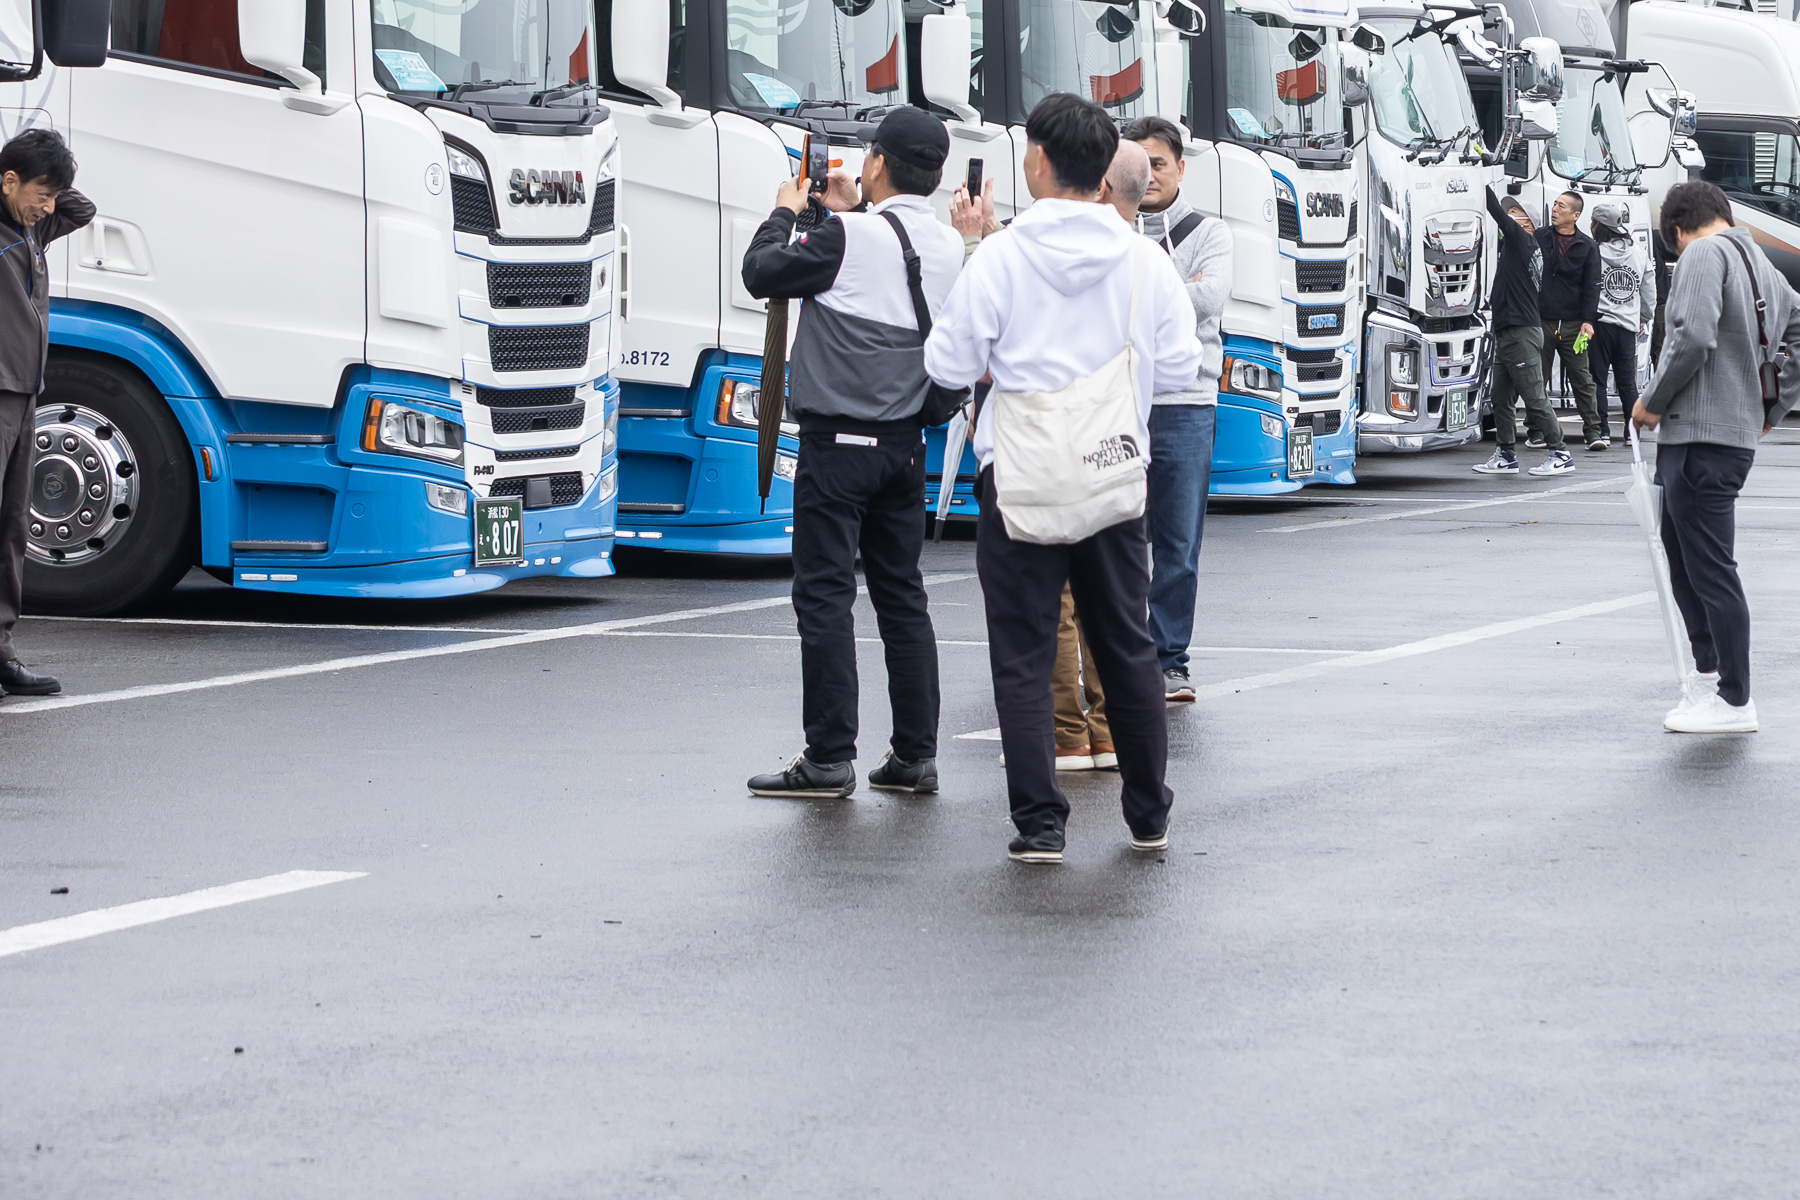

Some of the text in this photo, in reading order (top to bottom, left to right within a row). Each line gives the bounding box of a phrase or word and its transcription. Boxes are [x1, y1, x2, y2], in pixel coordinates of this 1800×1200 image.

[507, 168, 587, 206] SCANIA
[1415, 181, 1433, 190] GIGA
[1306, 191, 1345, 218] SCANIA
[1099, 435, 1120, 449] THE
[1083, 446, 1124, 465] NORTH
[1096, 456, 1126, 471] FACE
